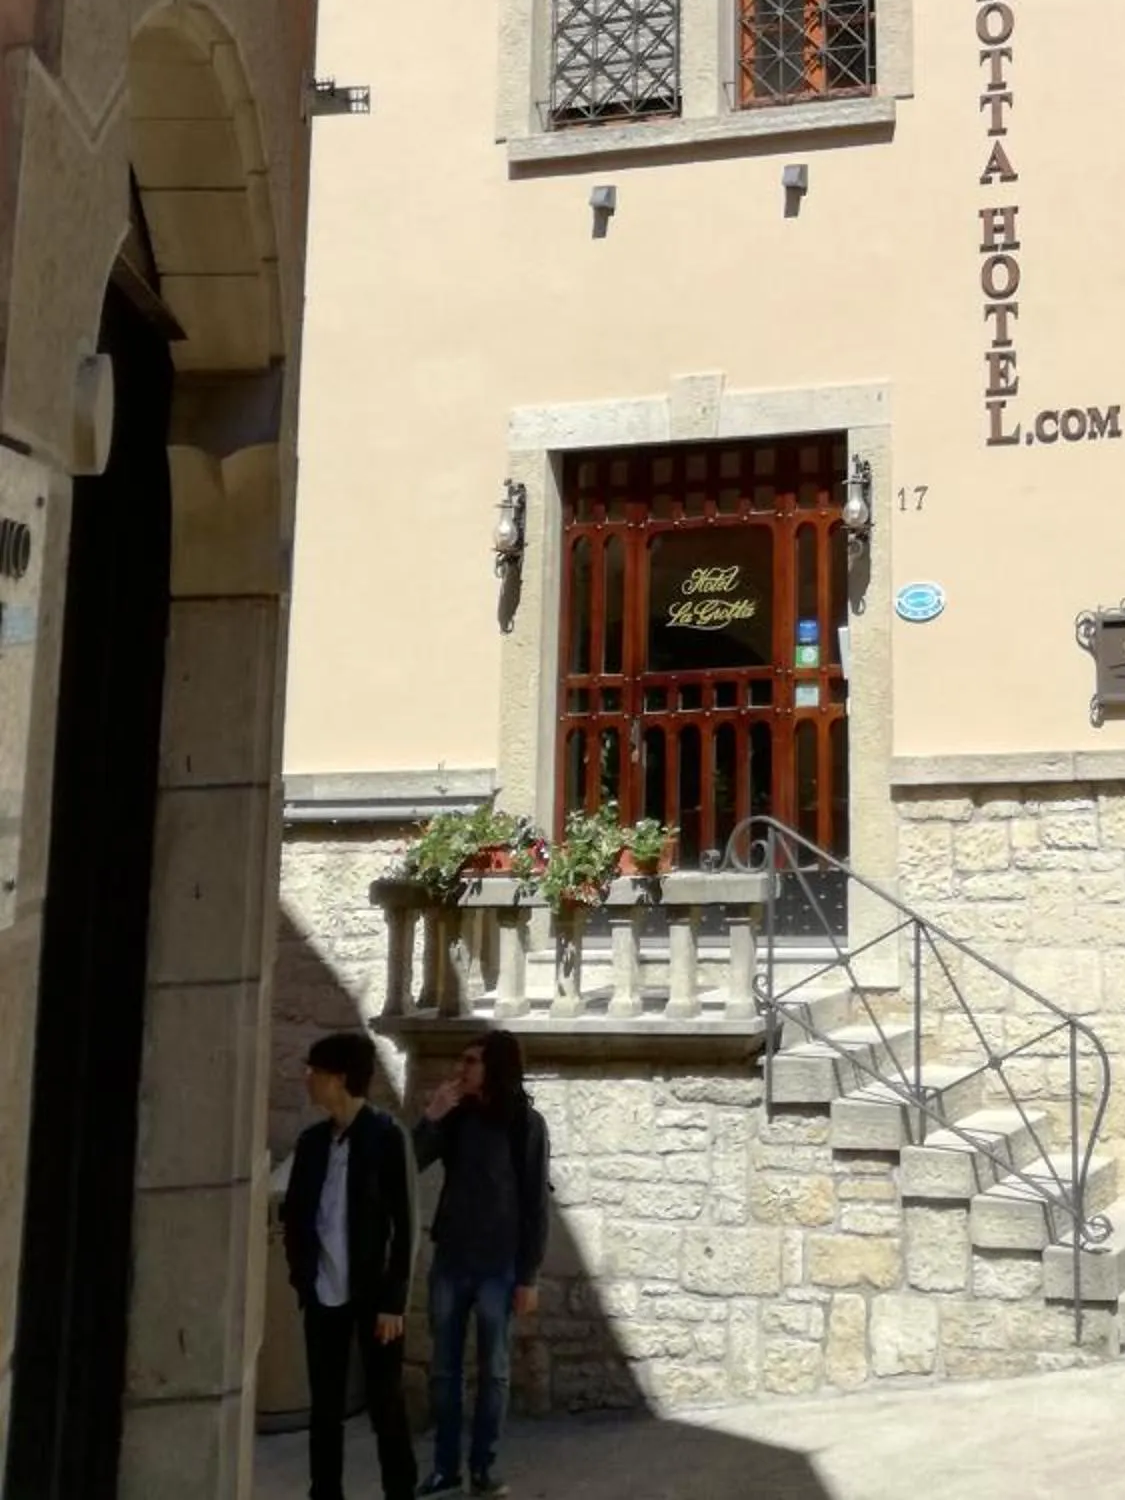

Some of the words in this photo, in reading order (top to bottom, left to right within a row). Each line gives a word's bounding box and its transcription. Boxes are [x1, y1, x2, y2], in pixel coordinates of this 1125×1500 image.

[897, 485, 929, 511] 17
[681, 565, 740, 594] Hotel
[665, 601, 694, 628] La
[694, 599, 757, 626] Grotta
